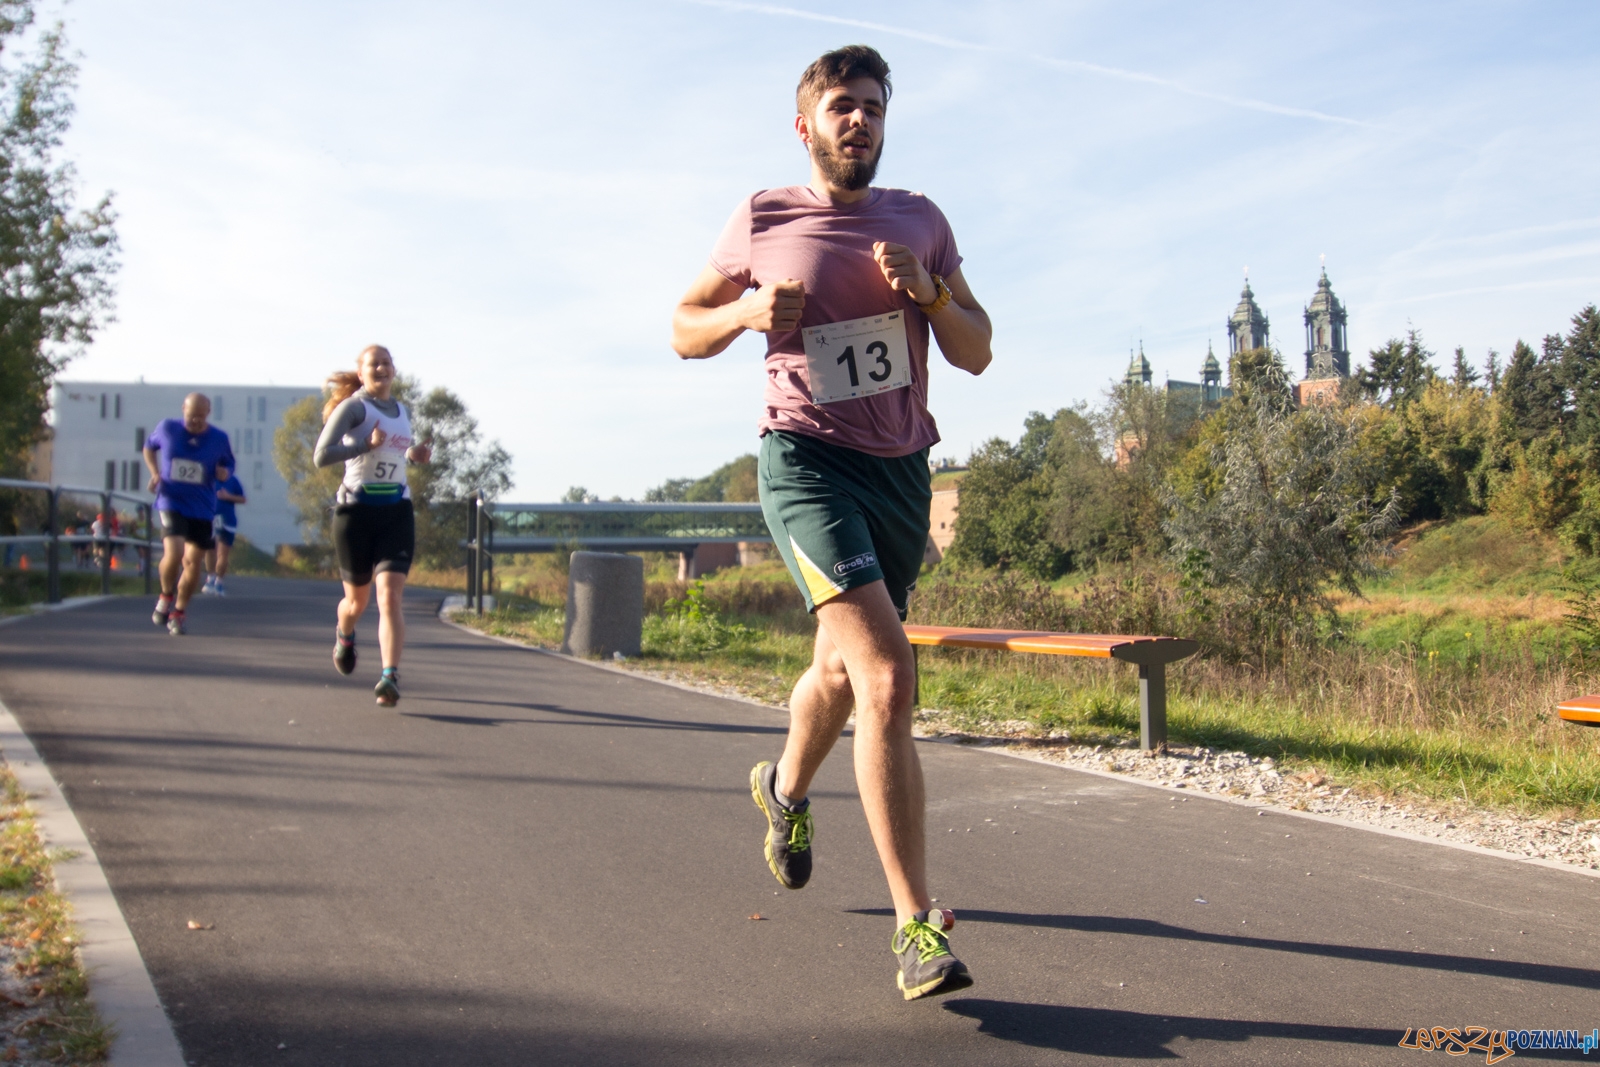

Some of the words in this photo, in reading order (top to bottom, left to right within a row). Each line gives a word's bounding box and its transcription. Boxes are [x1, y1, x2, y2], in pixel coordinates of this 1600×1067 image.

[837, 341, 892, 387] 13
[178, 465, 196, 479] 92
[374, 461, 398, 480] 57
